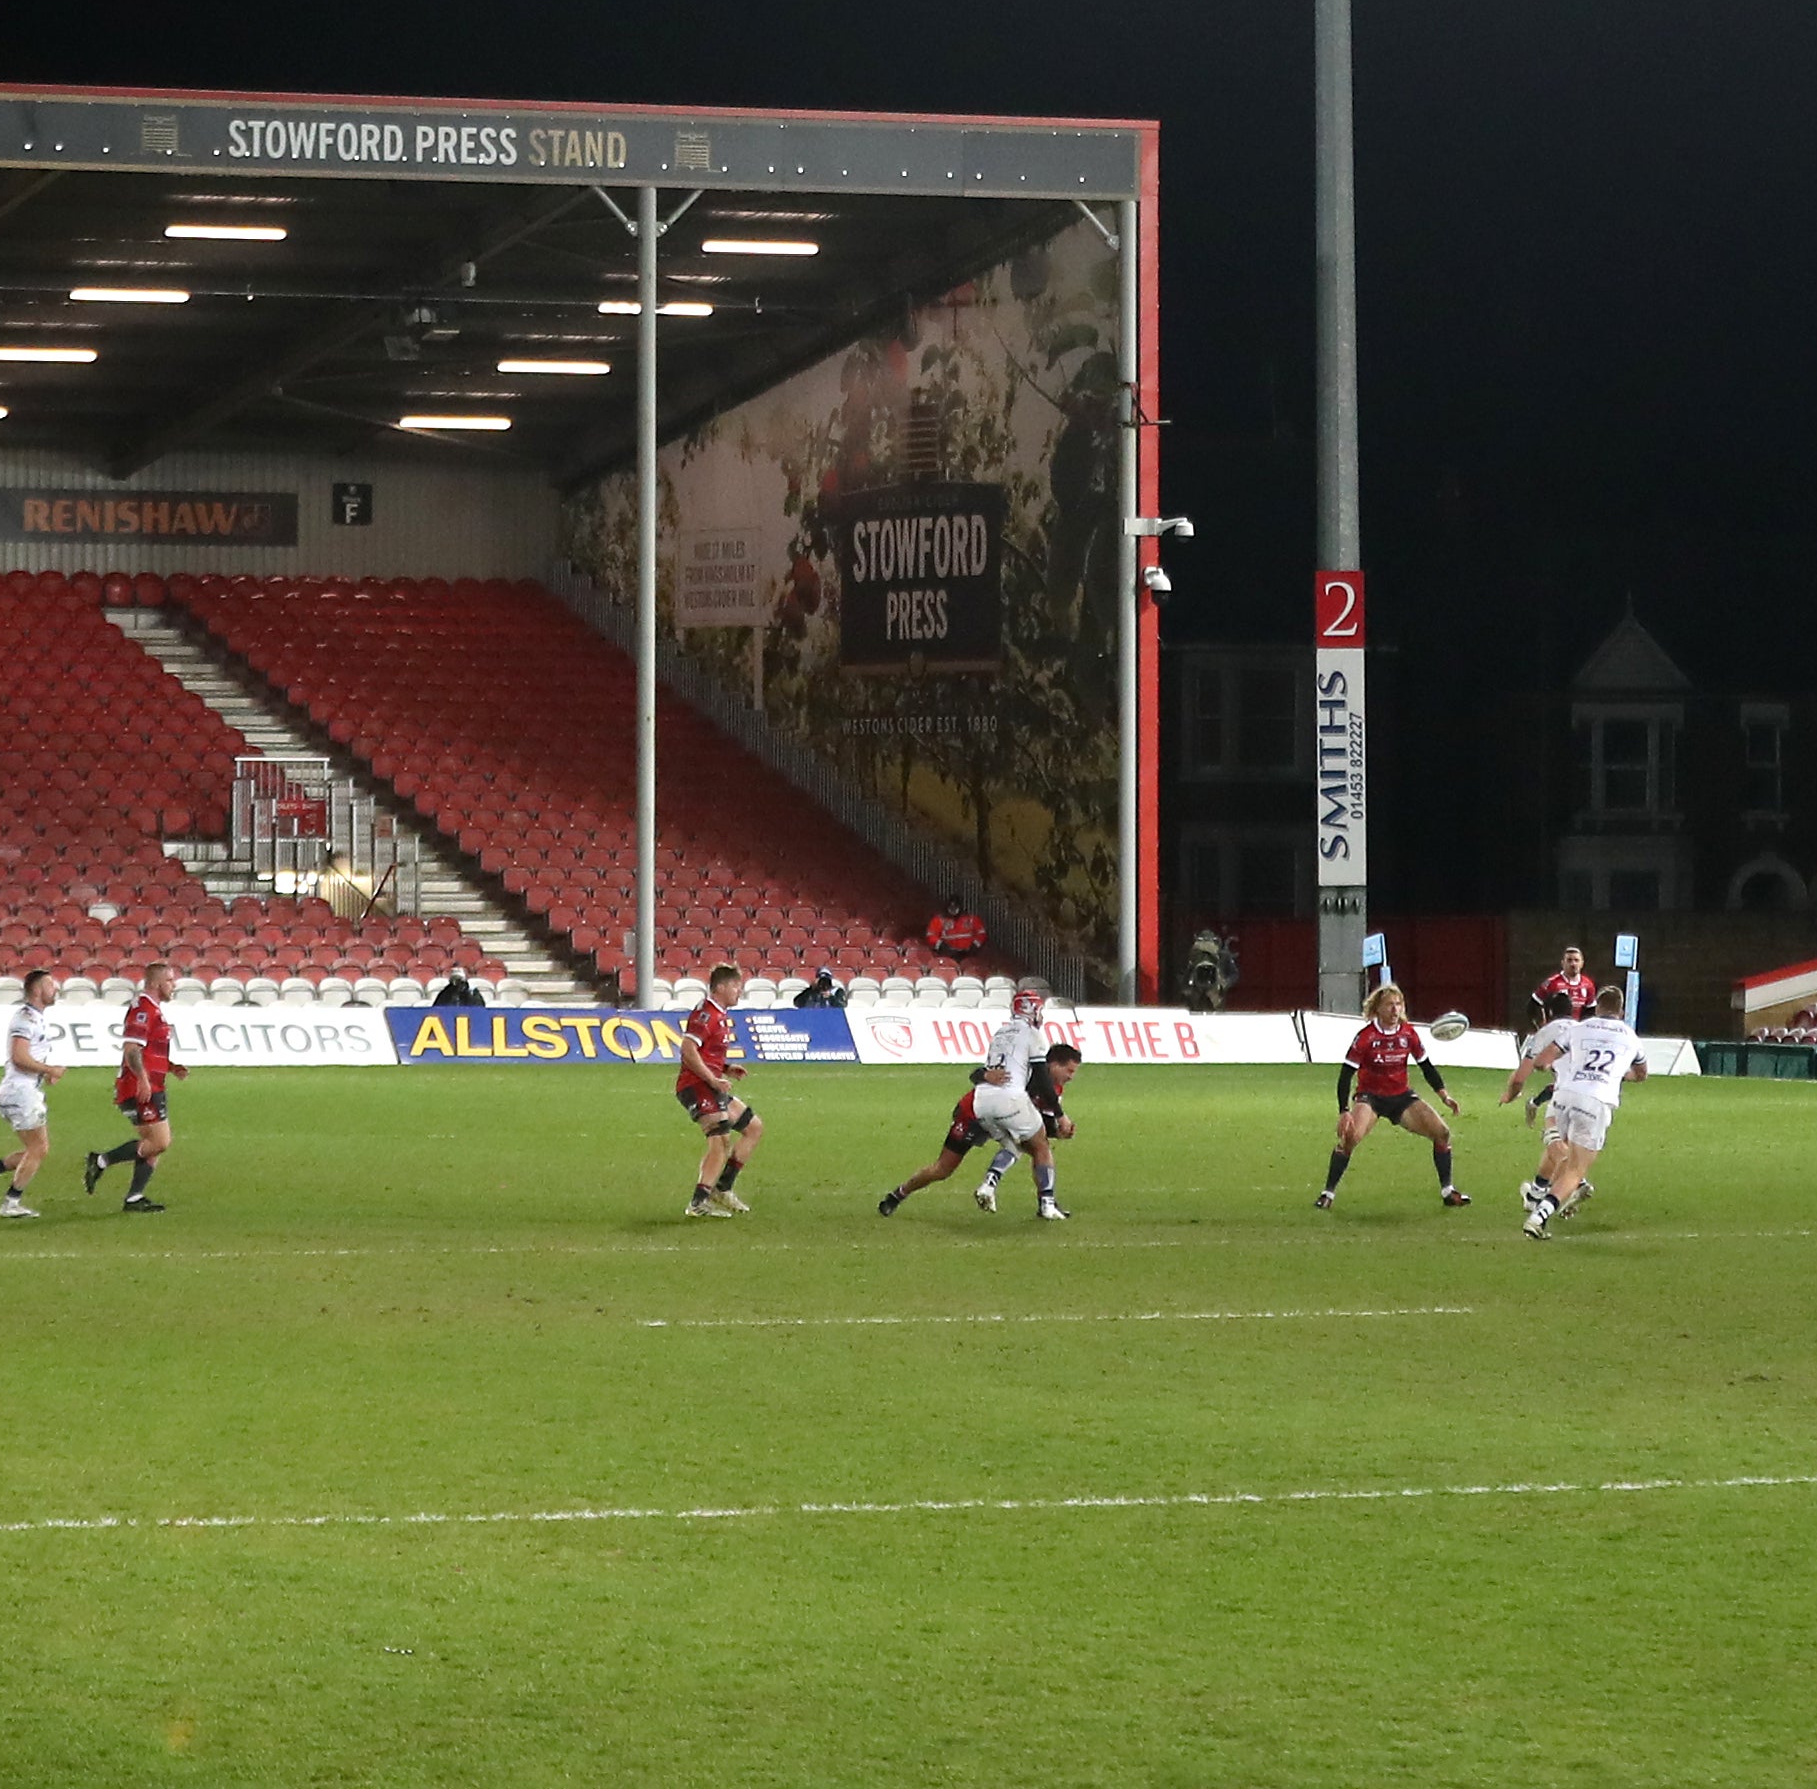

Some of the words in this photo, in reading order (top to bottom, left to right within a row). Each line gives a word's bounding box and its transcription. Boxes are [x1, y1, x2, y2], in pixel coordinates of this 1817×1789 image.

[227, 120, 404, 163] STOWFORD
[416, 127, 518, 166] PRESS
[528, 129, 628, 169] STAND
[22, 497, 239, 535] RENISHAW
[345, 503, 359, 524] F
[852, 514, 988, 583] STOWFORD
[886, 588, 949, 641] PRESS
[1322, 580, 1359, 637] 2
[841, 717, 895, 735] WESTONS
[896, 716, 933, 734] CIDER
[936, 716, 963, 734] EST.
[966, 715, 998, 733] 1880
[1348, 712, 1364, 768] 822227
[1318, 669, 1351, 862] SMITHS
[1349, 772, 1364, 819] 01453
[48, 1023, 98, 1053] PE
[108, 1022, 372, 1054] SLICITORS
[411, 1015, 744, 1059] ALLSTON
[1044, 1021, 1086, 1046] OF
[1095, 1021, 1169, 1059] THE
[1173, 1022, 1201, 1059] B
[1583, 1049, 1616, 1073] 22
